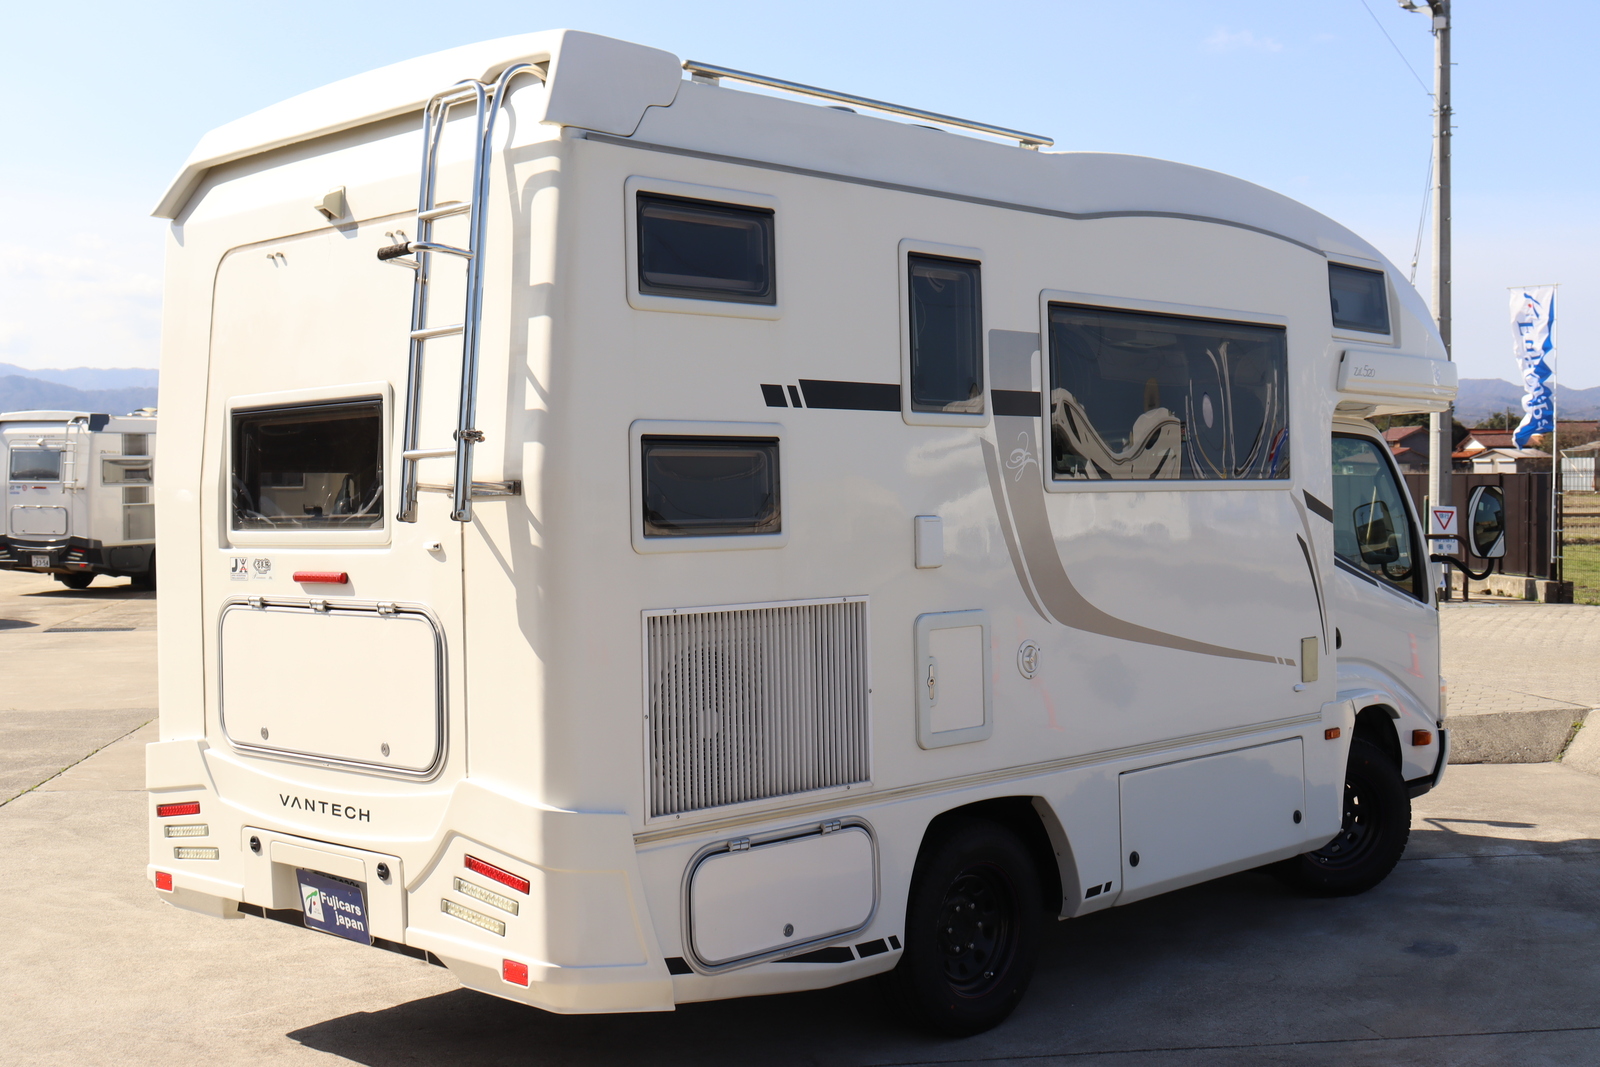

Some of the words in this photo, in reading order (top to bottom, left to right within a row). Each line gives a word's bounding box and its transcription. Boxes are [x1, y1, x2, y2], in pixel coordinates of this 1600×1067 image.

[279, 793, 370, 823] VANTECH
[320, 891, 362, 916] Fujicars
[334, 910, 365, 932] japan
